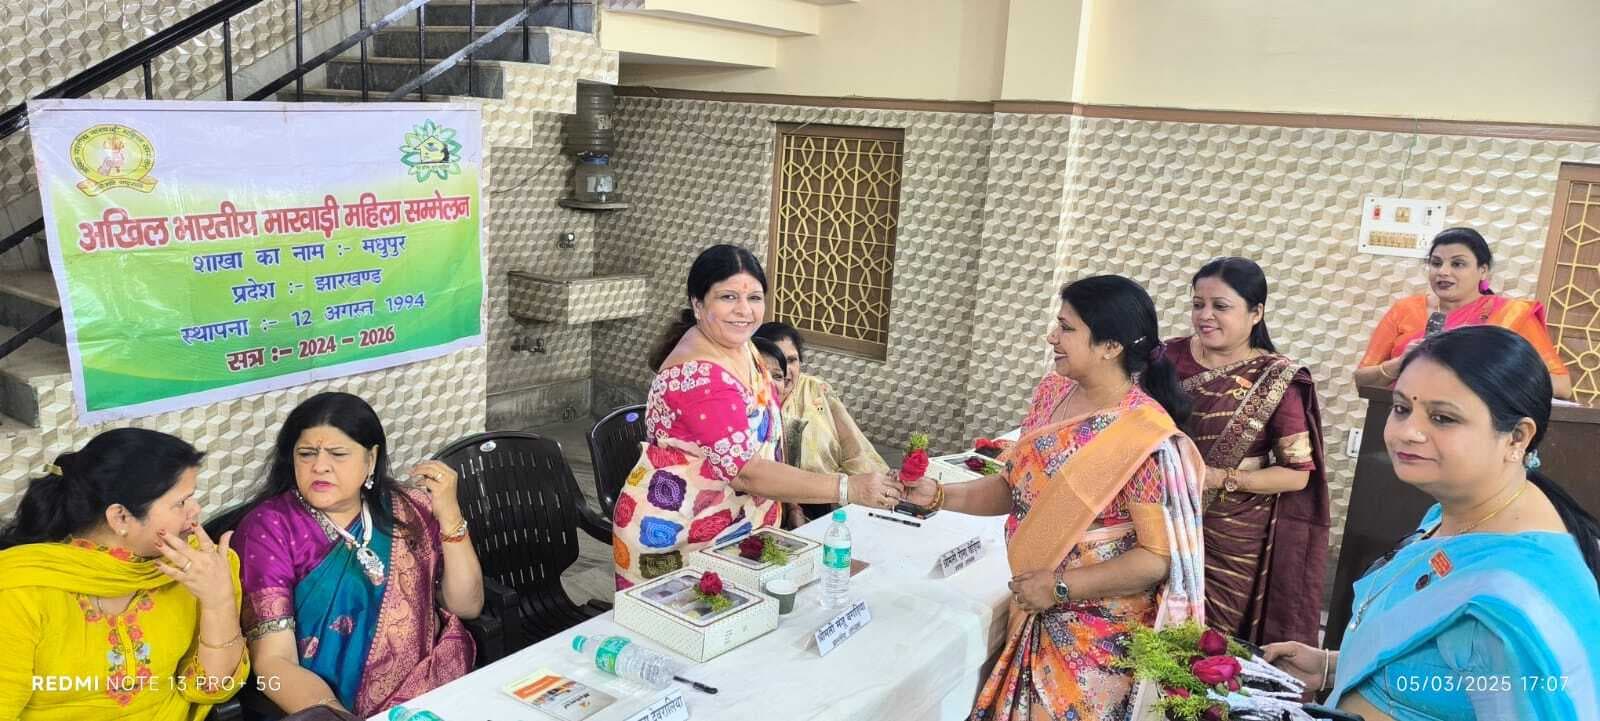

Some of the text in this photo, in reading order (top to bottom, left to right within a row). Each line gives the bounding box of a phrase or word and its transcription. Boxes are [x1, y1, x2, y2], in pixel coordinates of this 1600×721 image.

[79, 190, 470, 251] अखिल भारतीय मारवाड़ी महिला सम्मेलन
[193, 252, 243, 272] शाखा
[256, 248, 280, 266] का
[292, 244, 324, 261] नाम
[362, 236, 406, 258] मधुपुर
[232, 278, 275, 303] प्रदेश
[315, 269, 382, 291] झारखण्ड
[181, 319, 248, 343] स्थापना
[292, 310, 312, 327] 12
[326, 300, 374, 320] अगस्त
[386, 294, 425, 312] 1994
[227, 348, 265, 372] सत्र
[299, 336, 336, 357] 2024
[360, 326, 395, 347] 2026
